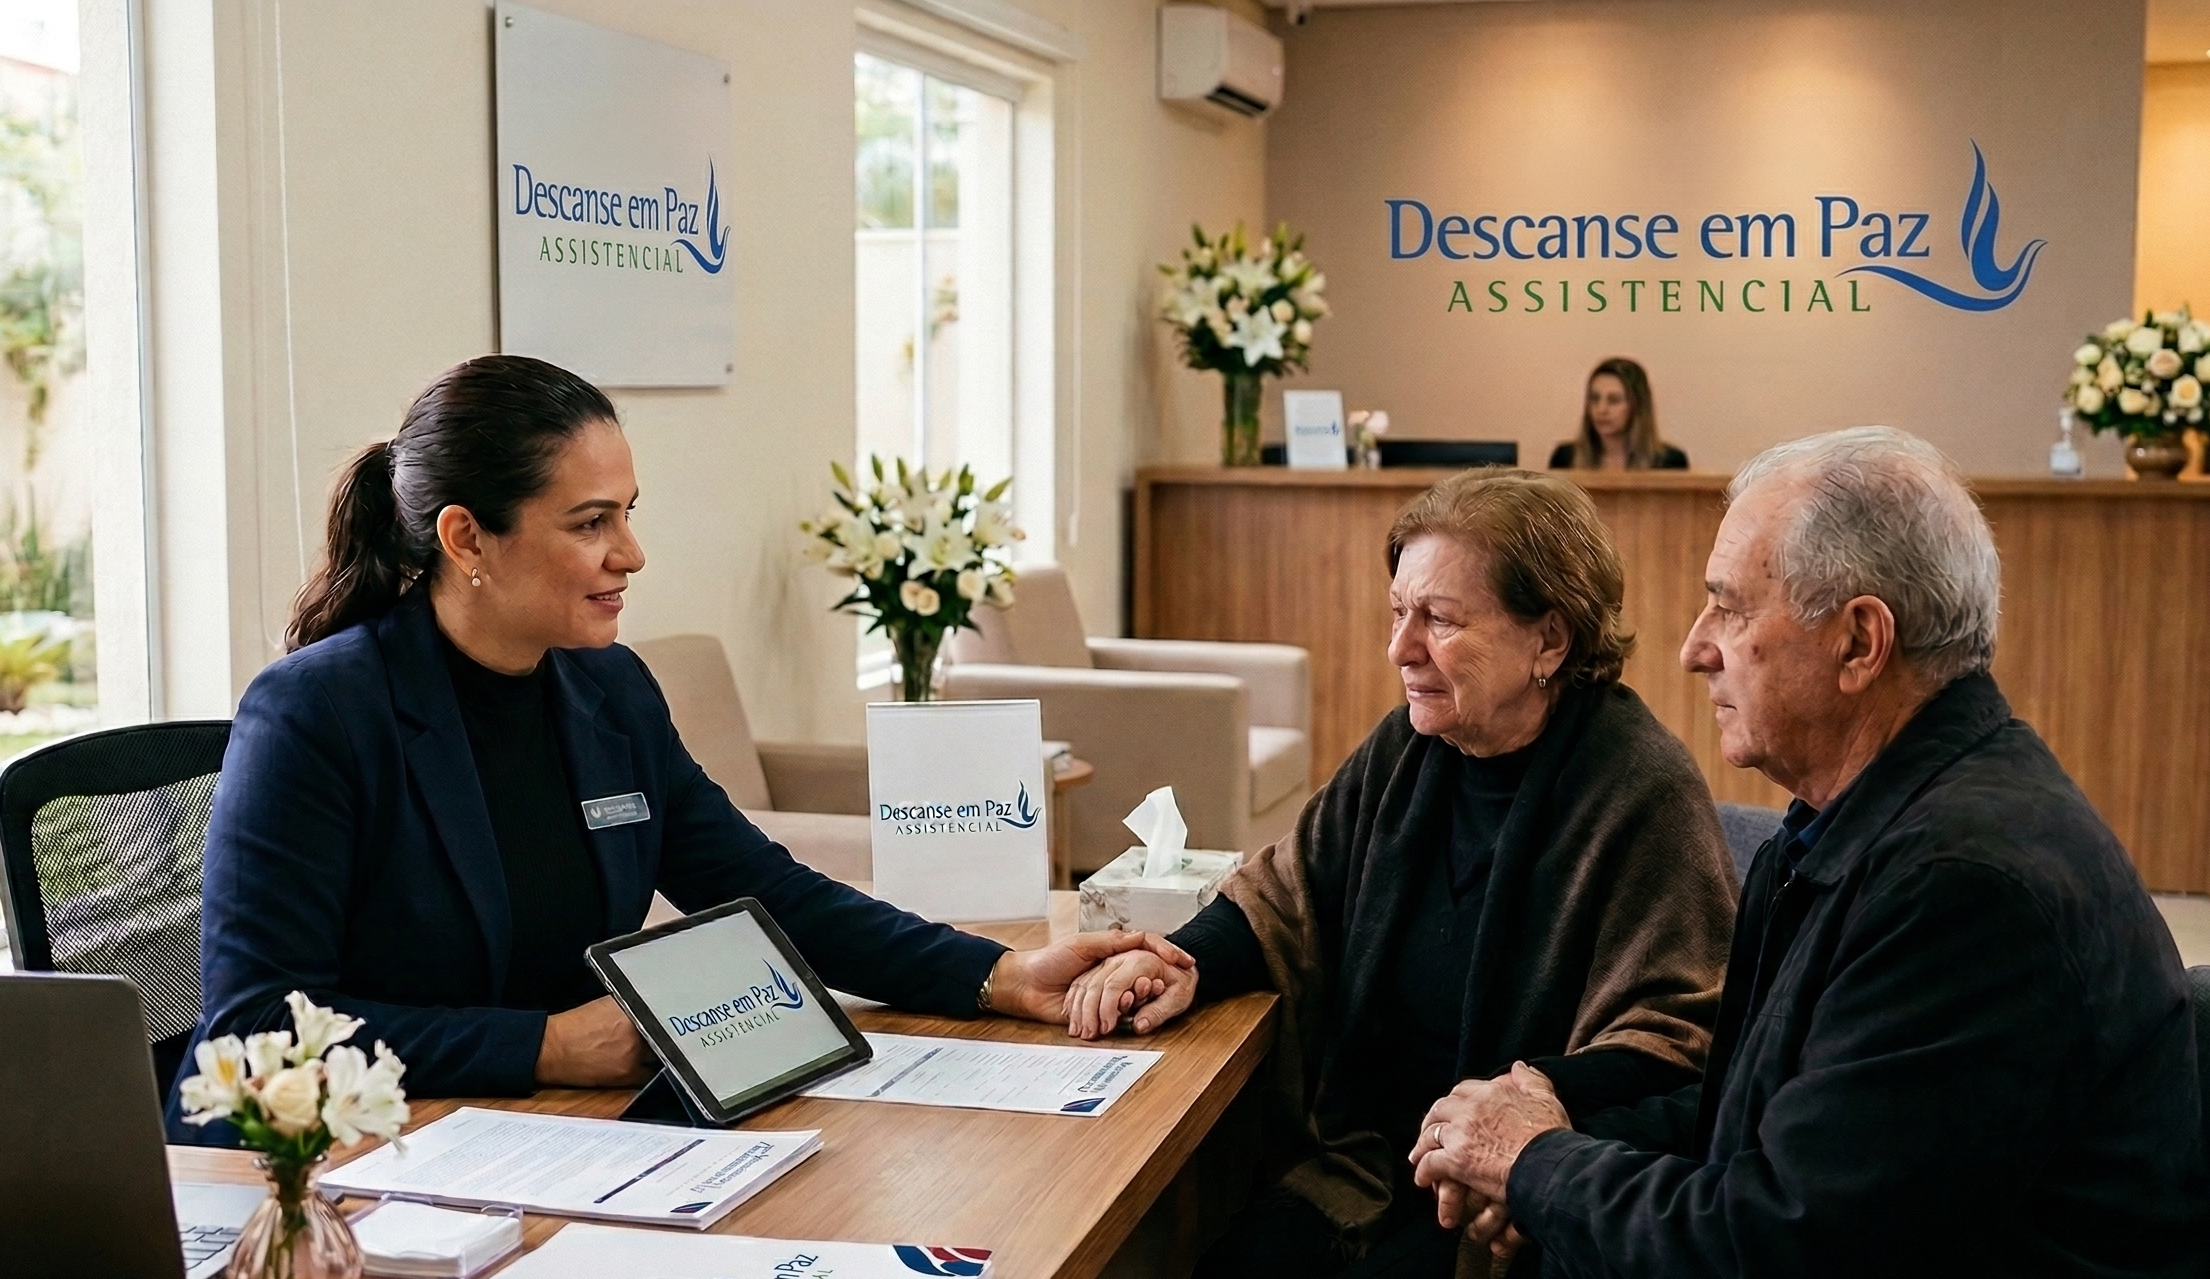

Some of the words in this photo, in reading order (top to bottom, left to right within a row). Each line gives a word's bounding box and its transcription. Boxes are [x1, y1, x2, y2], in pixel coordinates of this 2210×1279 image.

[512, 163, 622, 227] Descanse
[628, 195, 659, 231] em
[664, 187, 699, 235] Paz
[1384, 199, 1679, 260] Descanse
[1700, 212, 1796, 259] em
[1815, 195, 1930, 259] Paz
[539, 236, 684, 274] ASSISTENCIAL
[1447, 279, 1871, 313] ASSISTENCIAL
[879, 803, 952, 821] Descanse
[956, 804, 980, 818] em
[985, 799, 1012, 817] Paz
[895, 821, 1002, 835] ASSISTENCIAL
[669, 1003, 735, 1036] Descanse
[733, 995, 756, 1014] em
[750, 985, 779, 1006] Paz
[774, 1254, 819, 1273] Paz
